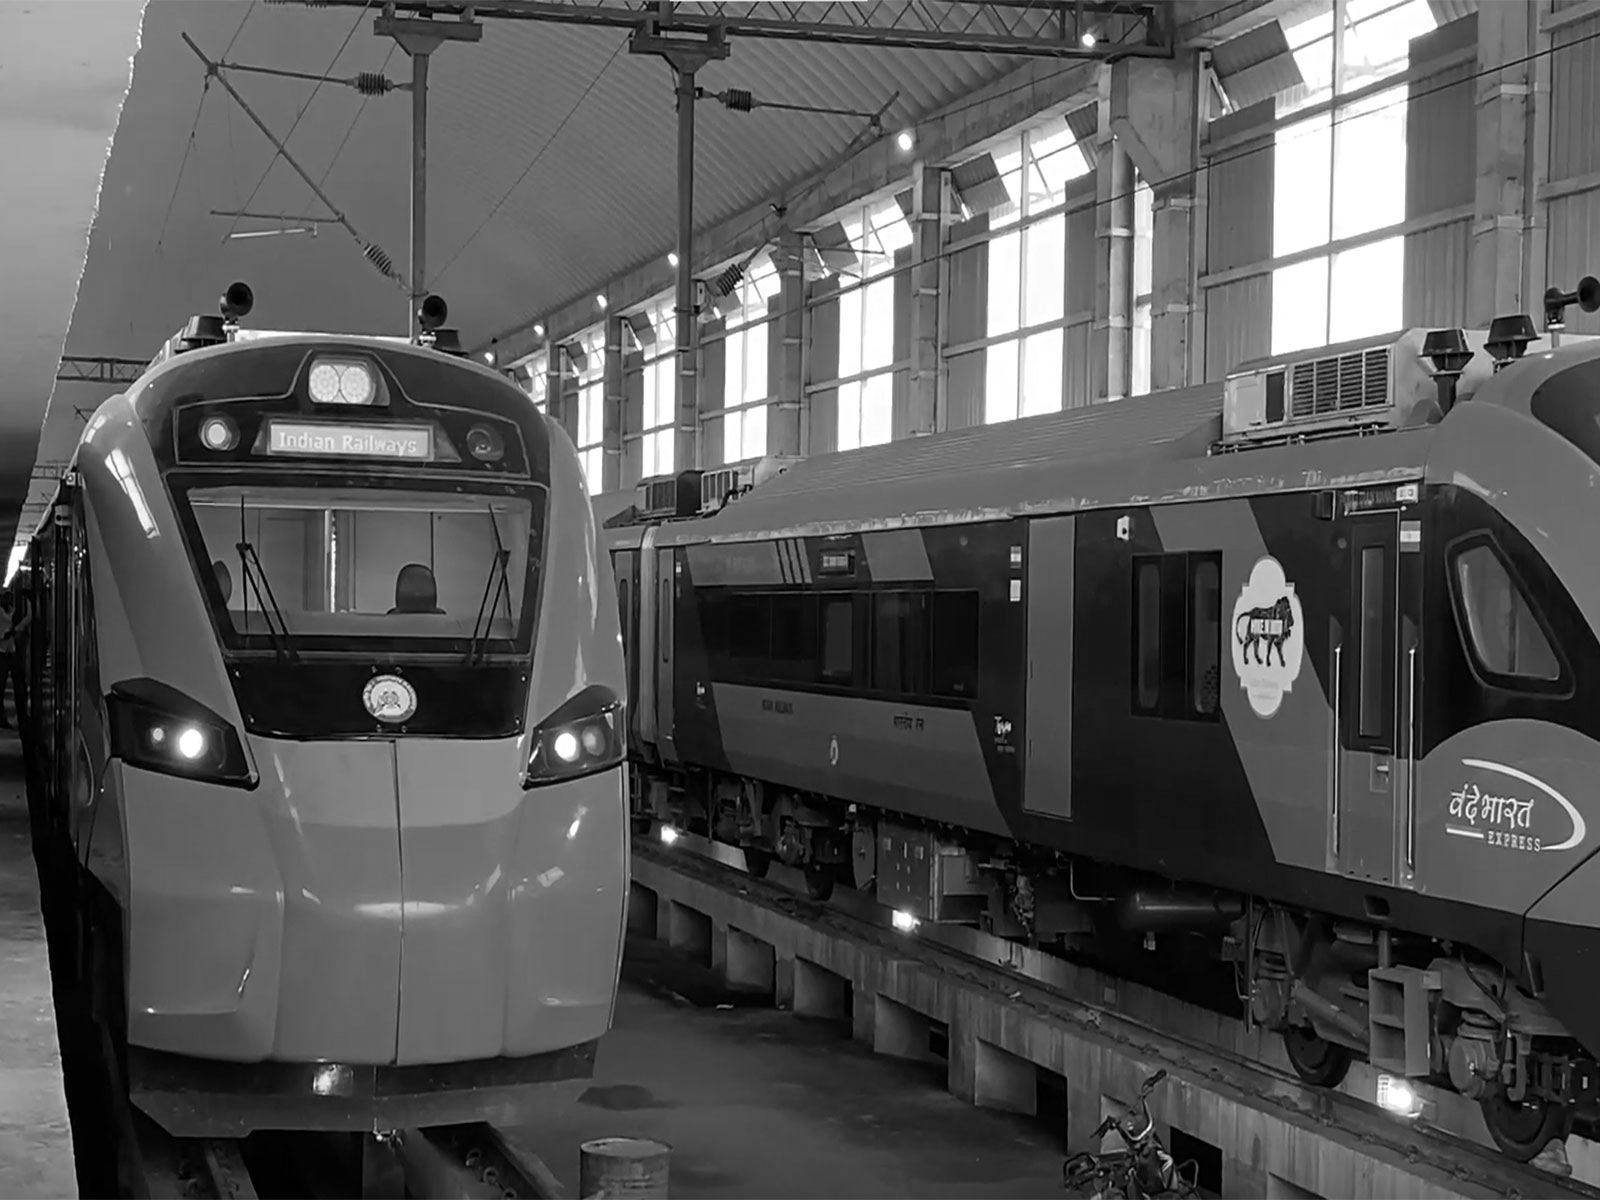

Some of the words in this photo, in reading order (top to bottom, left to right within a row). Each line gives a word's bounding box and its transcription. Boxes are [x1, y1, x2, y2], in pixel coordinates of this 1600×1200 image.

[279, 432, 335, 451] Indian
[342, 434, 417, 456] Railways
[1487, 830, 1541, 852] EXPRESS
